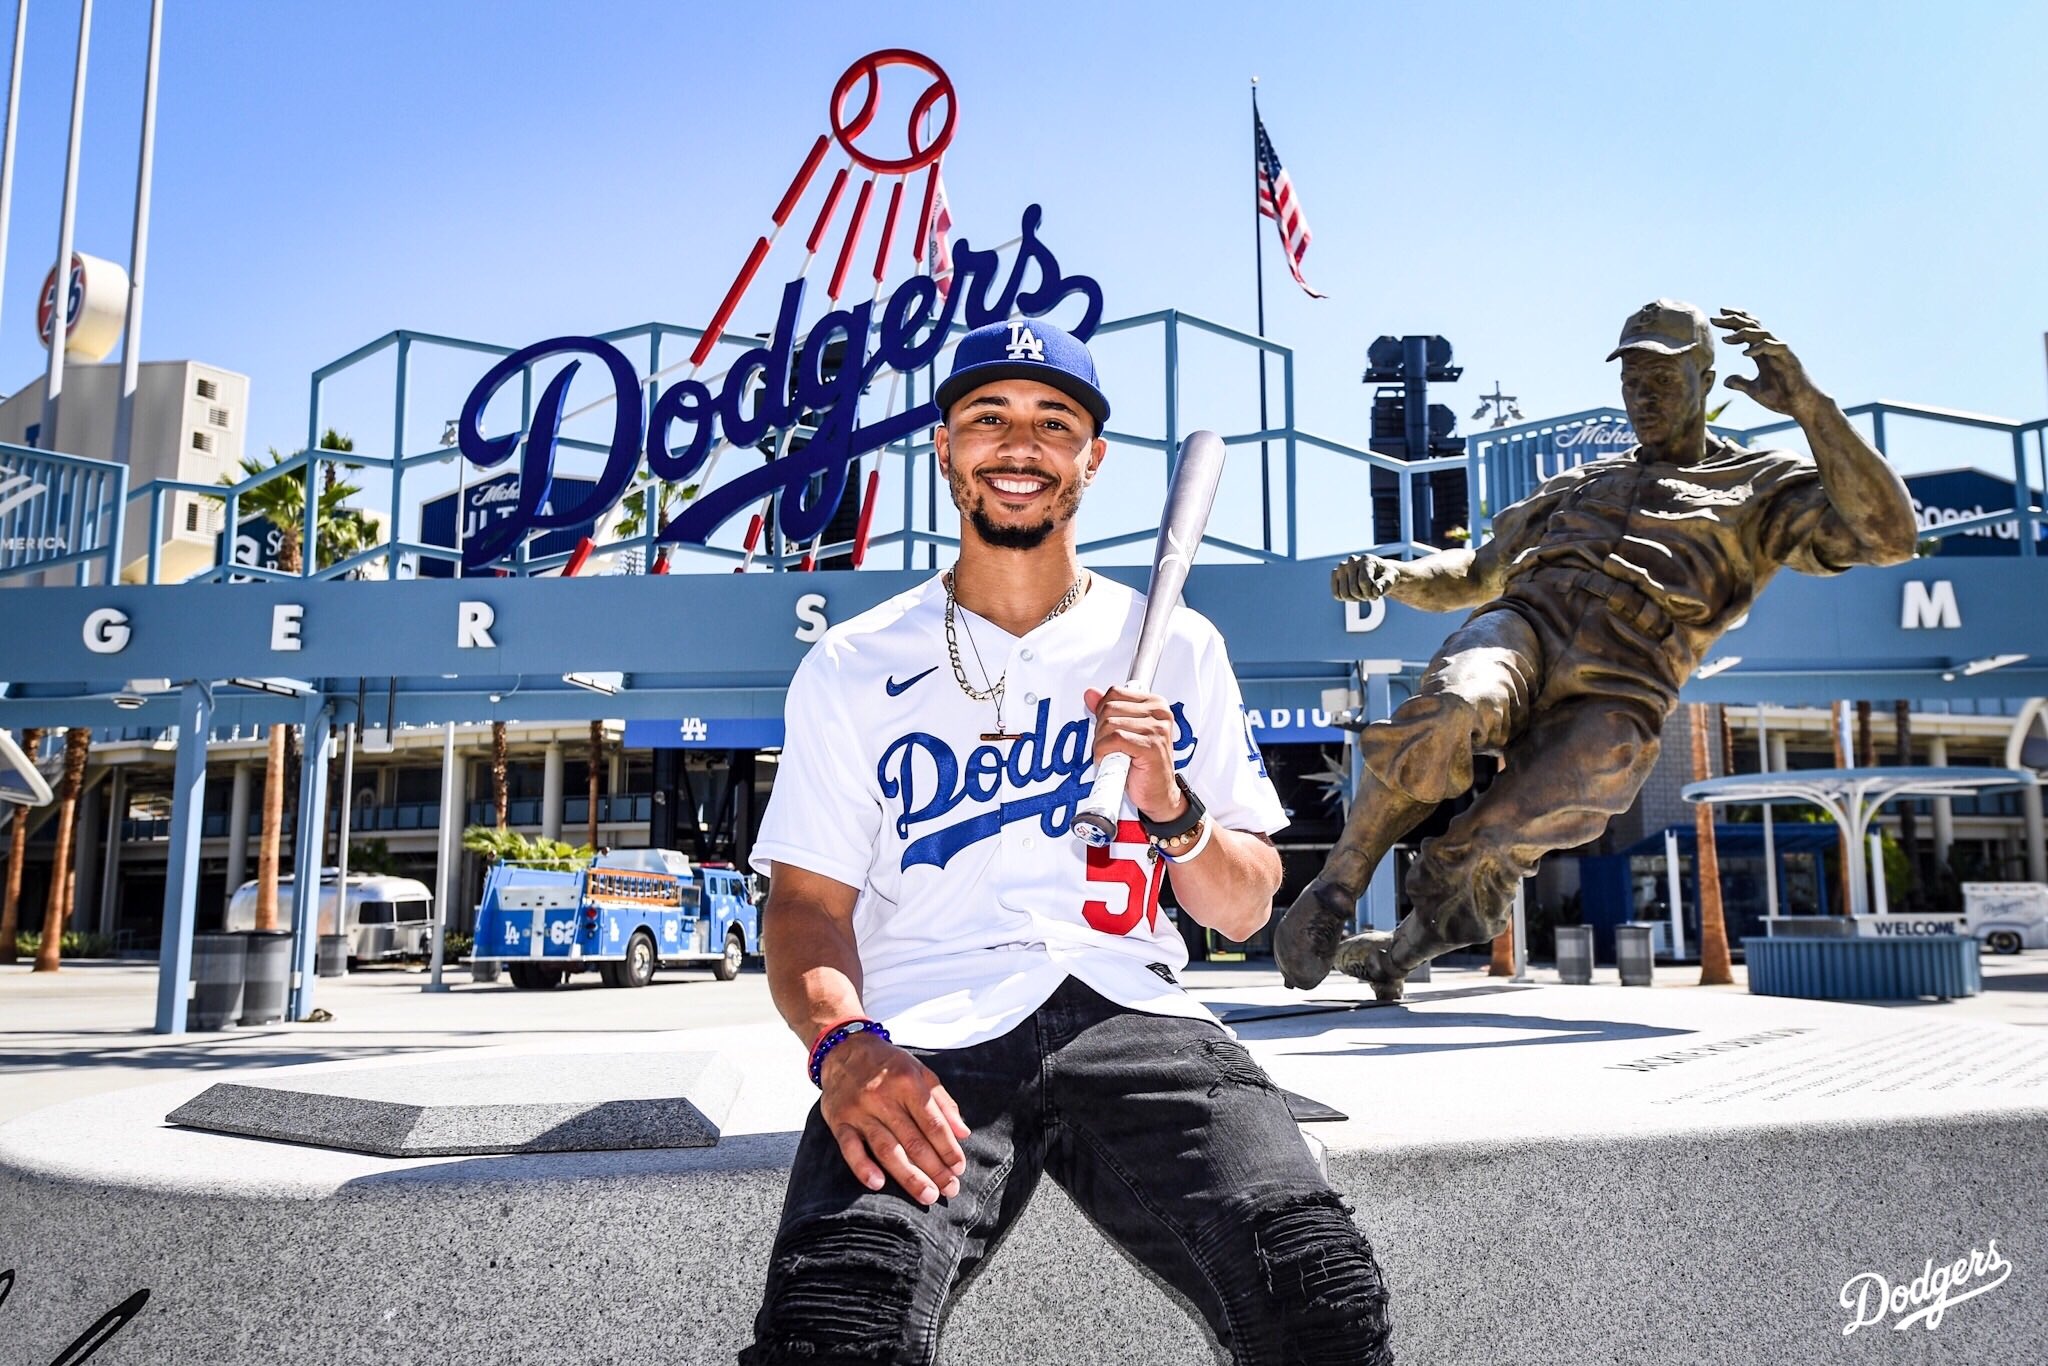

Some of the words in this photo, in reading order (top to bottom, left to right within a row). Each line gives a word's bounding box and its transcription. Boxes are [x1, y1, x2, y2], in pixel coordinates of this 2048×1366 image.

[1006, 322, 1045, 361] LA
[459, 203, 1103, 570] Dodgers
[0, 537, 67, 550] MERICA
[680, 717, 707, 741] LA
[877, 697, 1199, 873] Dodgs
[504, 921, 520, 945] LA
[1873, 920, 1956, 937] WELCOME
